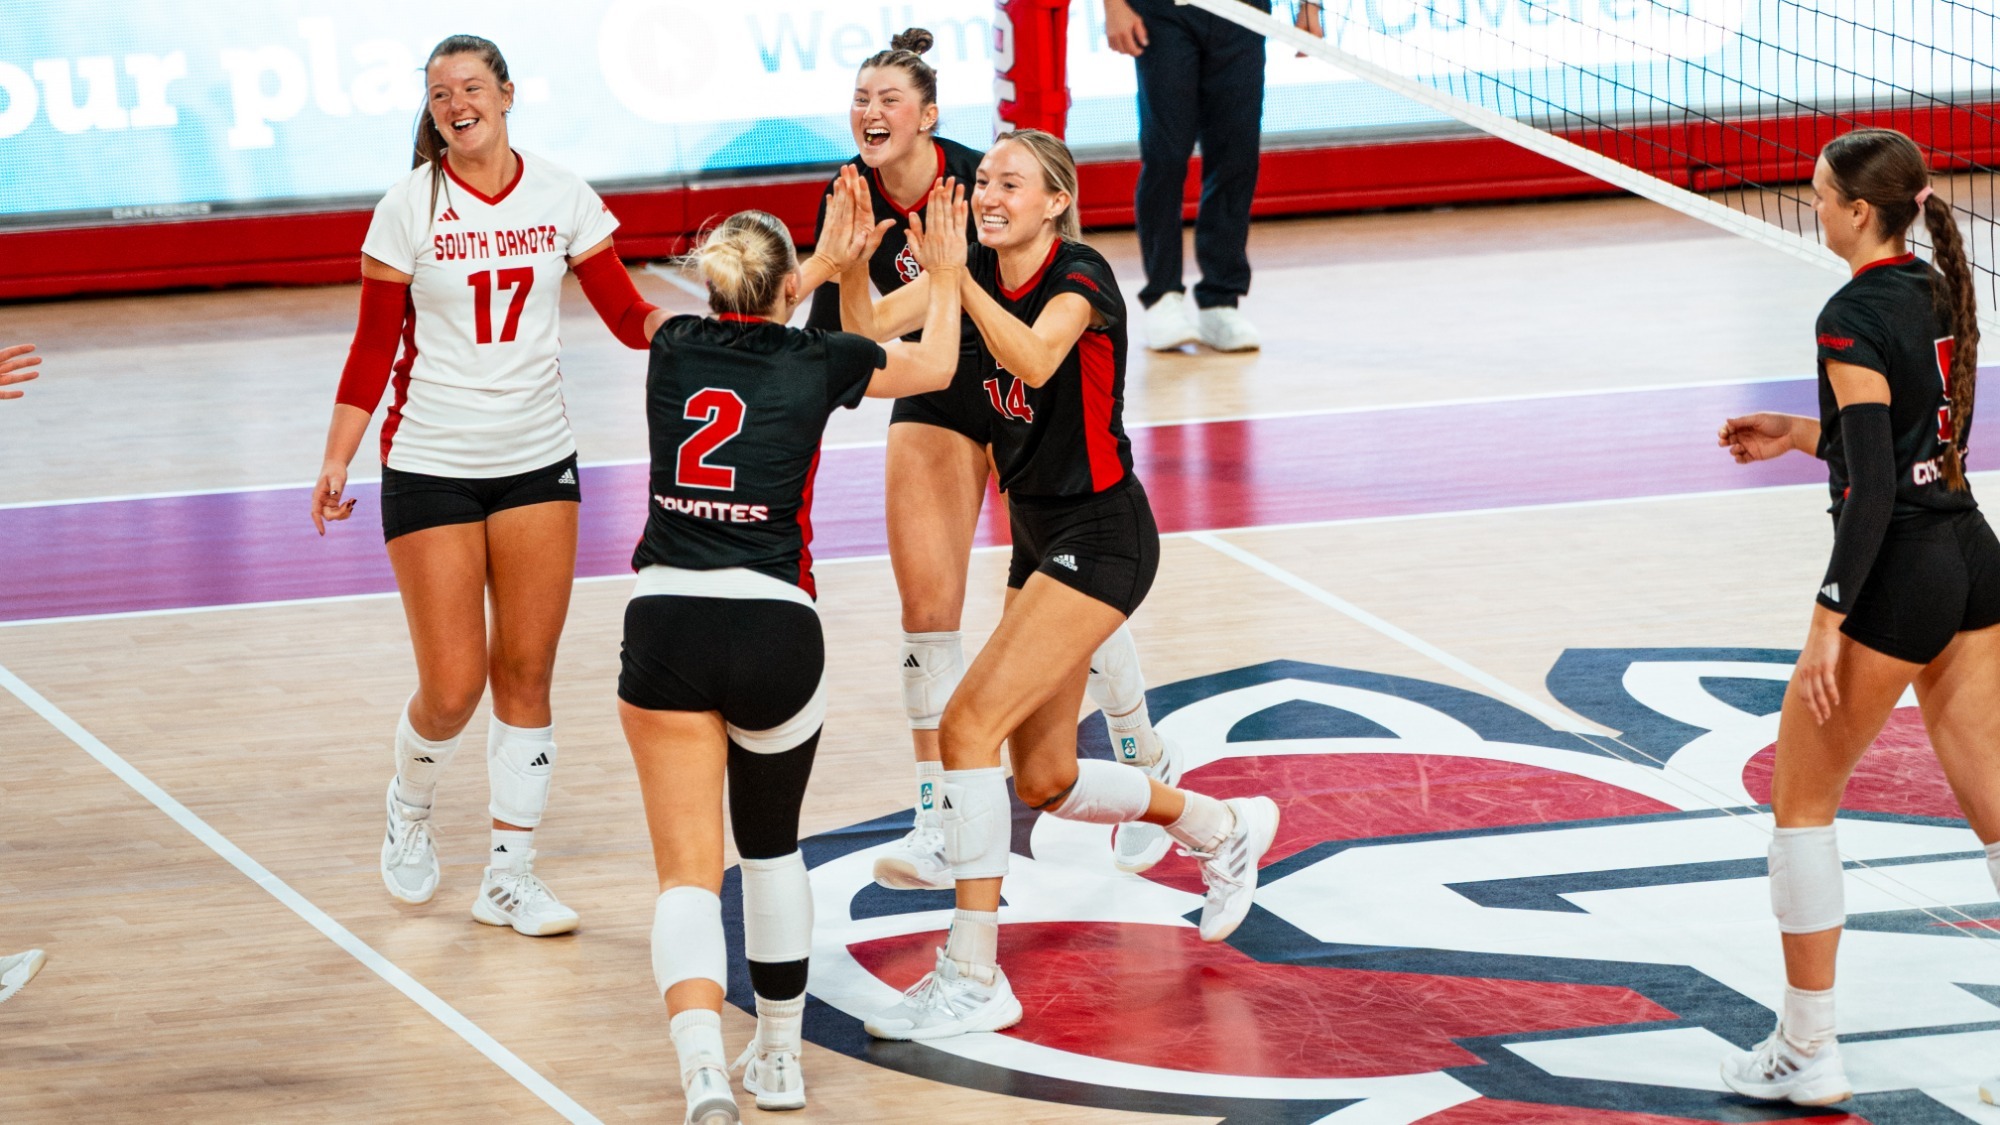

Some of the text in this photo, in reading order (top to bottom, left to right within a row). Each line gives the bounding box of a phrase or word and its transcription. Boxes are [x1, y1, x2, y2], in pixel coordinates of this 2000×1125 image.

[434, 225, 557, 261] SOUTH DAKOTA
[467, 266, 535, 344] 17
[983, 376, 1034, 423] 14
[675, 387, 747, 492] 2
